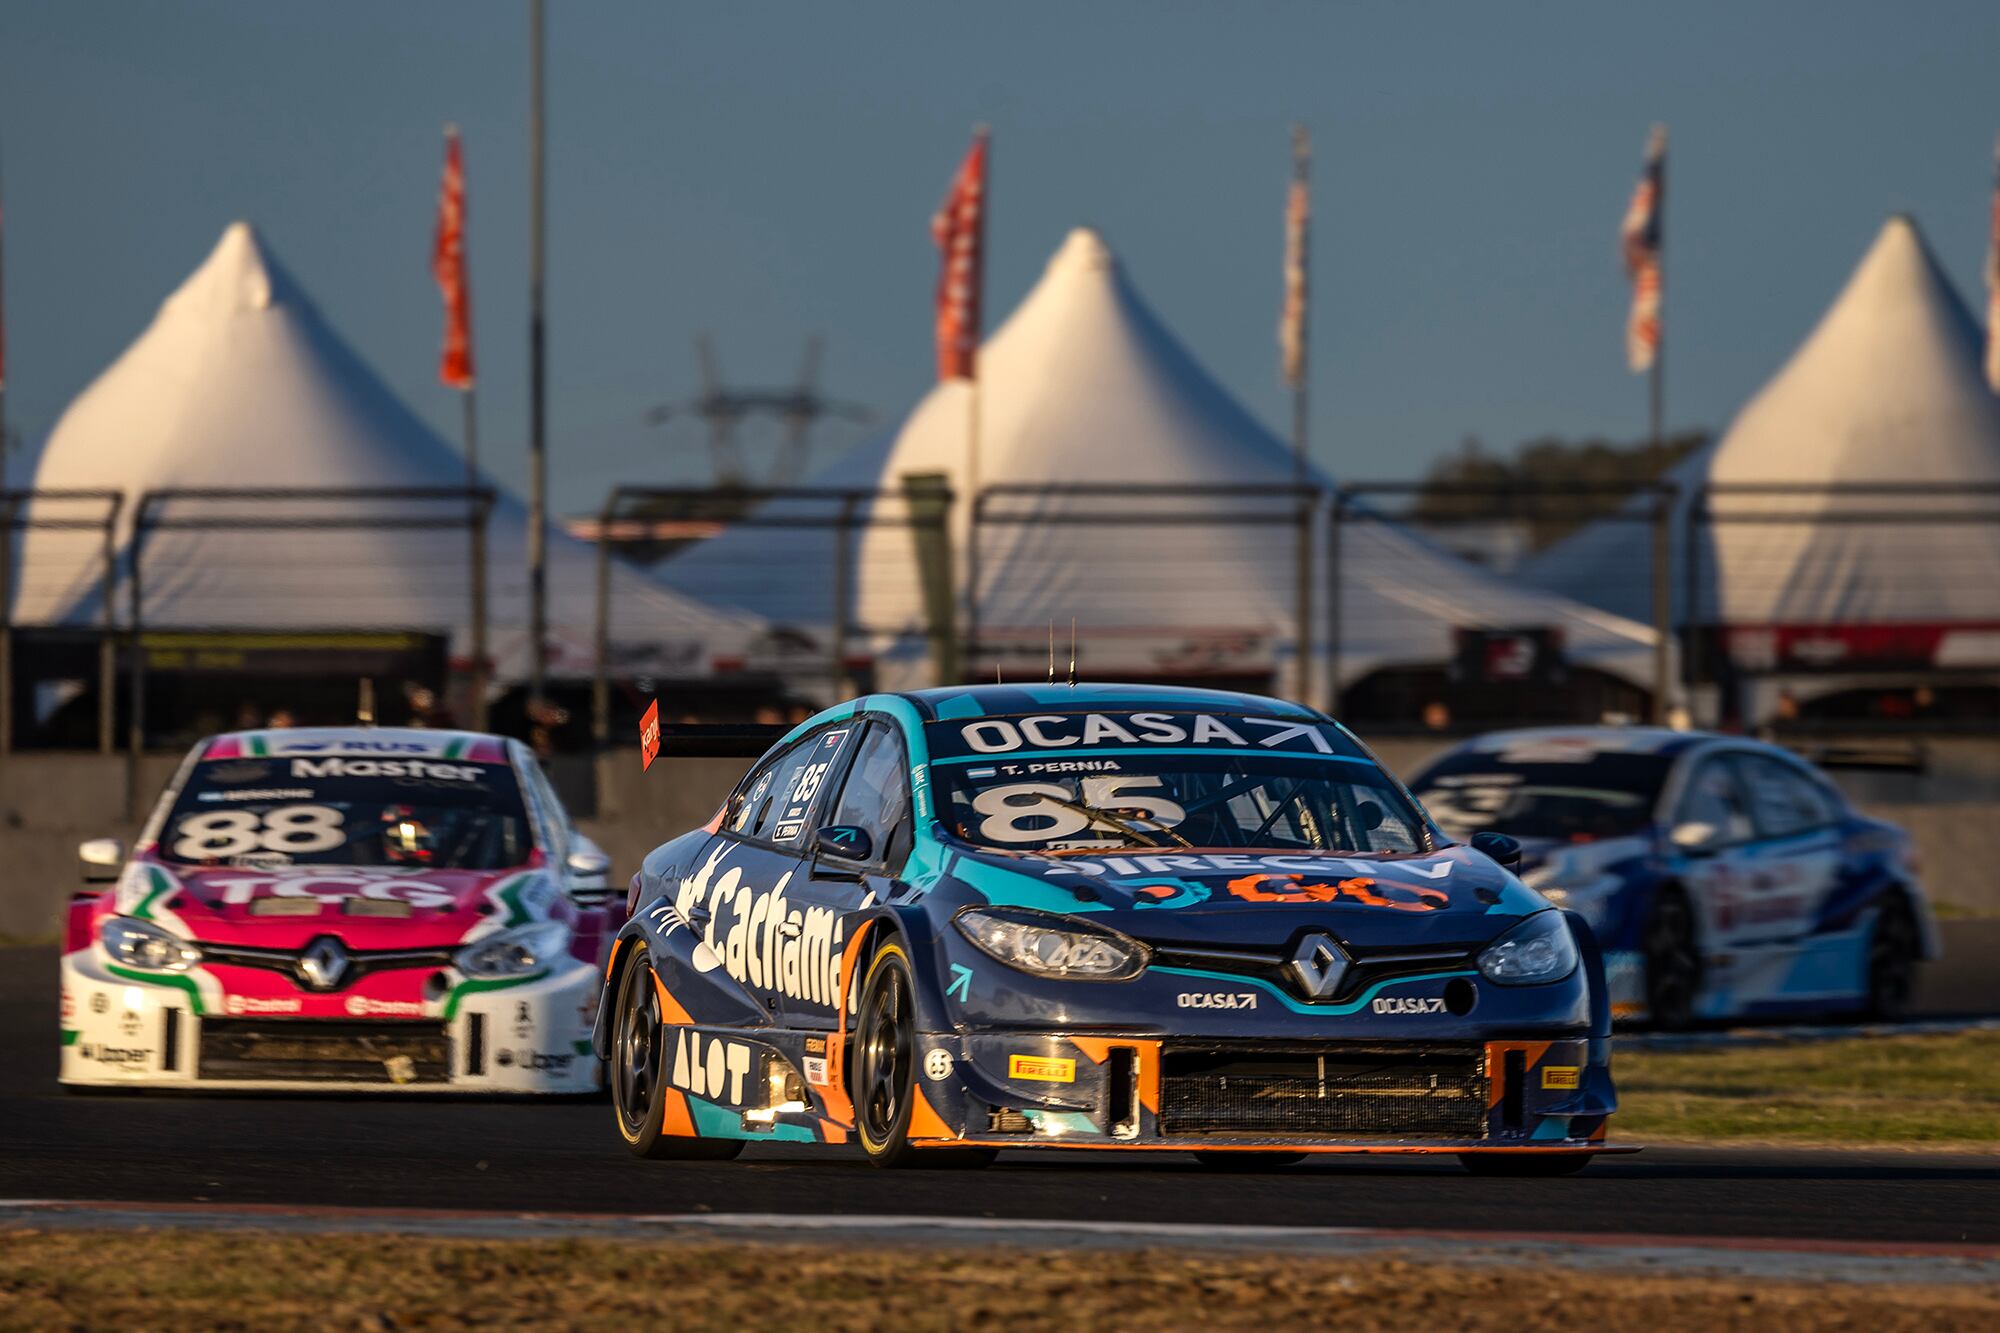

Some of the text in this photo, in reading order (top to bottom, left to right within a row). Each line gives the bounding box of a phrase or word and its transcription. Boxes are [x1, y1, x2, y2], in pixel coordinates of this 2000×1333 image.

[961, 713, 1249, 753] OCASA
[290, 757, 486, 782] Master
[1001, 760, 1122, 776] T. PERNIA
[792, 763, 828, 803] 85
[972, 775, 1187, 844] 85
[173, 804, 347, 860] 88
[1044, 854, 1455, 880] DIRECTV
[1176, 993, 1238, 1010] OCASA
[1372, 998, 1429, 1014] OCASA
[673, 1027, 750, 1106] ALOT
[1016, 1060, 1068, 1078] PIRELLI
